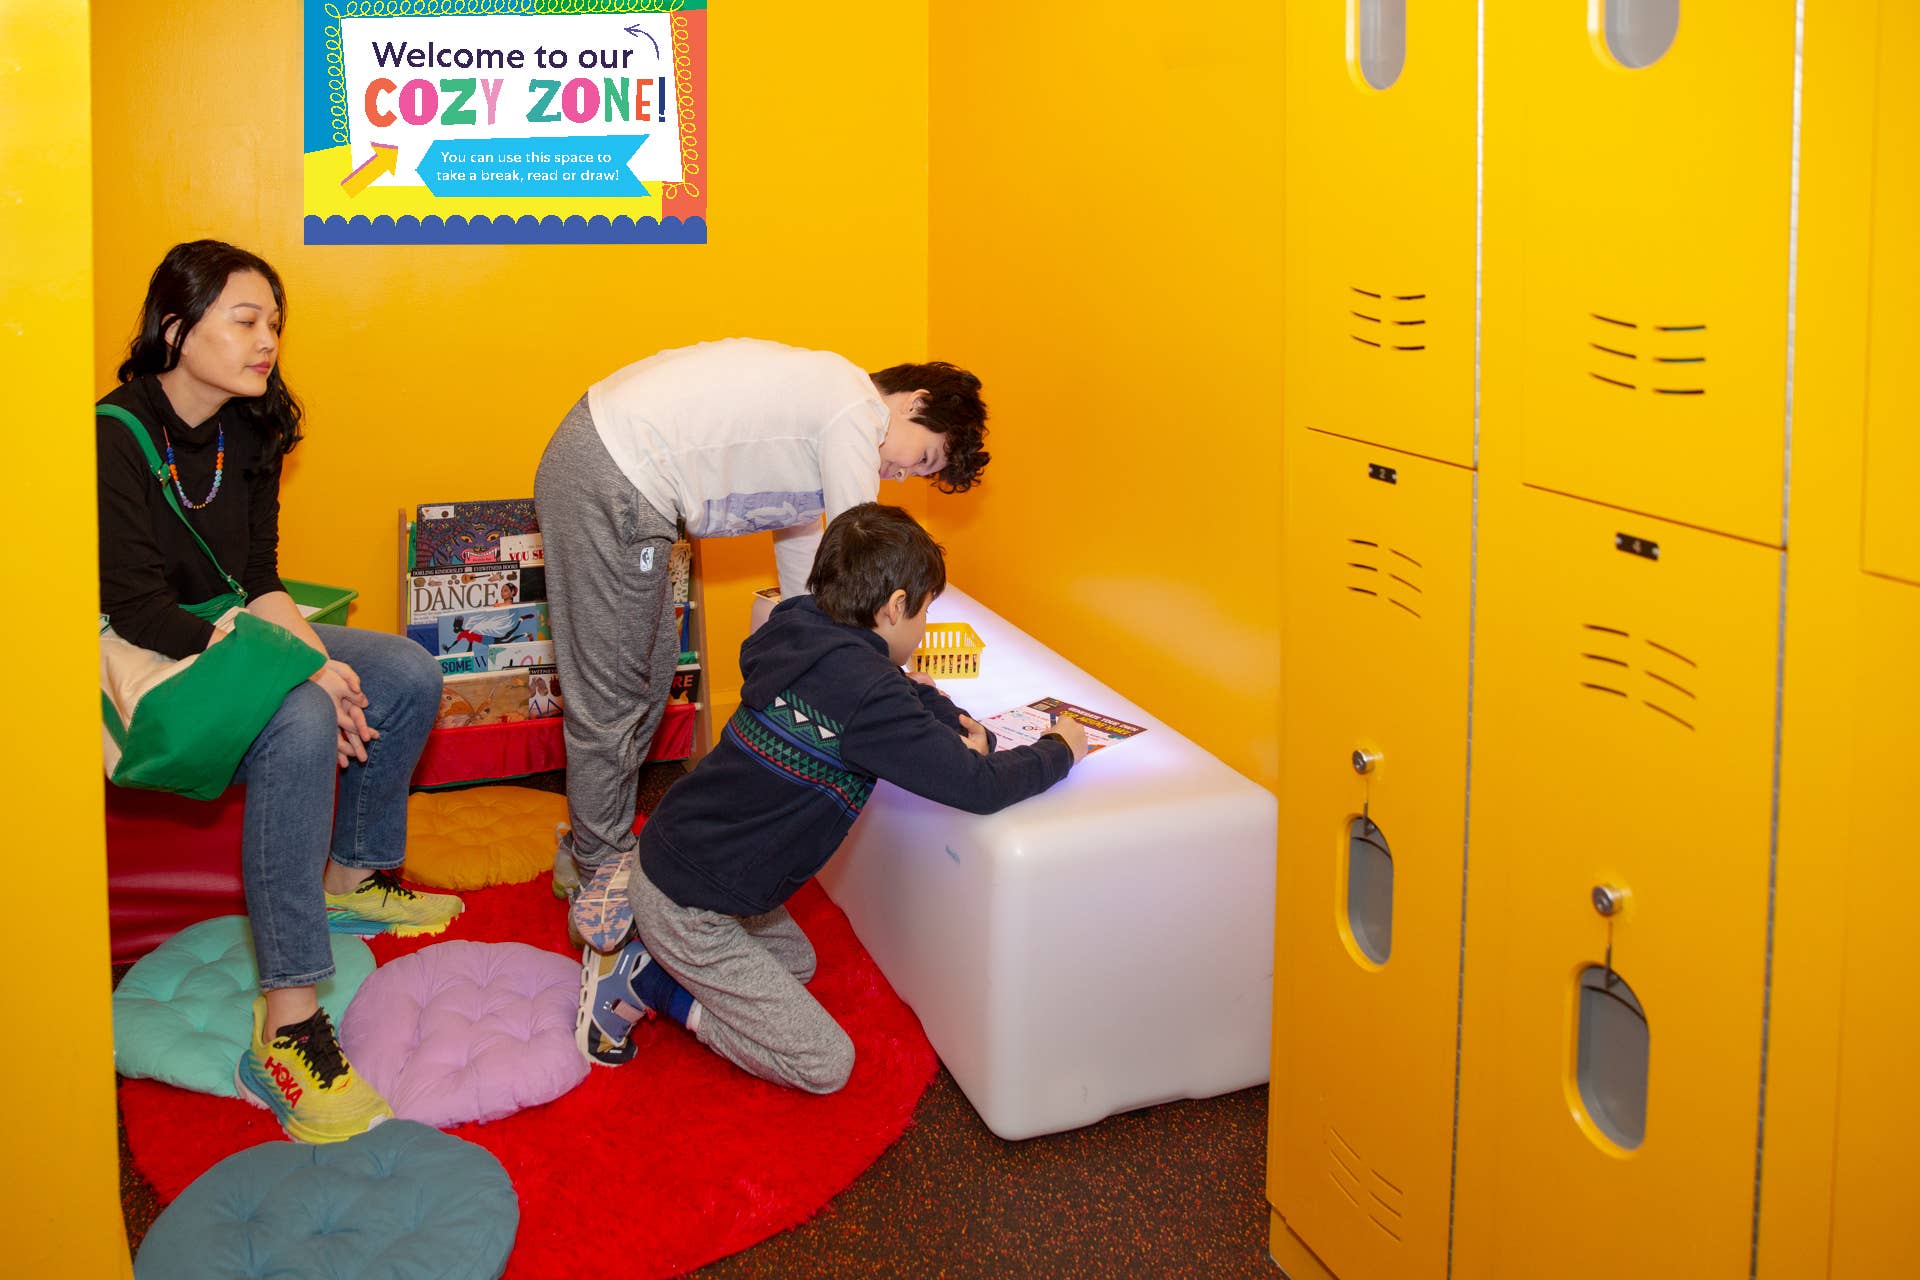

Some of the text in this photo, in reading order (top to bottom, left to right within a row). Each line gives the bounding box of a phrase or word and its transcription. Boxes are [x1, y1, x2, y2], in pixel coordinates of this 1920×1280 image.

[372, 41, 634, 68] Welcome to our
[365, 77, 665, 127] COZY ZONE!
[440, 151, 612, 166] You can use this space to
[436, 169, 619, 183] take a break, read or draw!
[509, 551, 529, 562] YOU
[414, 583, 498, 612] DANCE
[264, 1056, 303, 1109] HOKA
